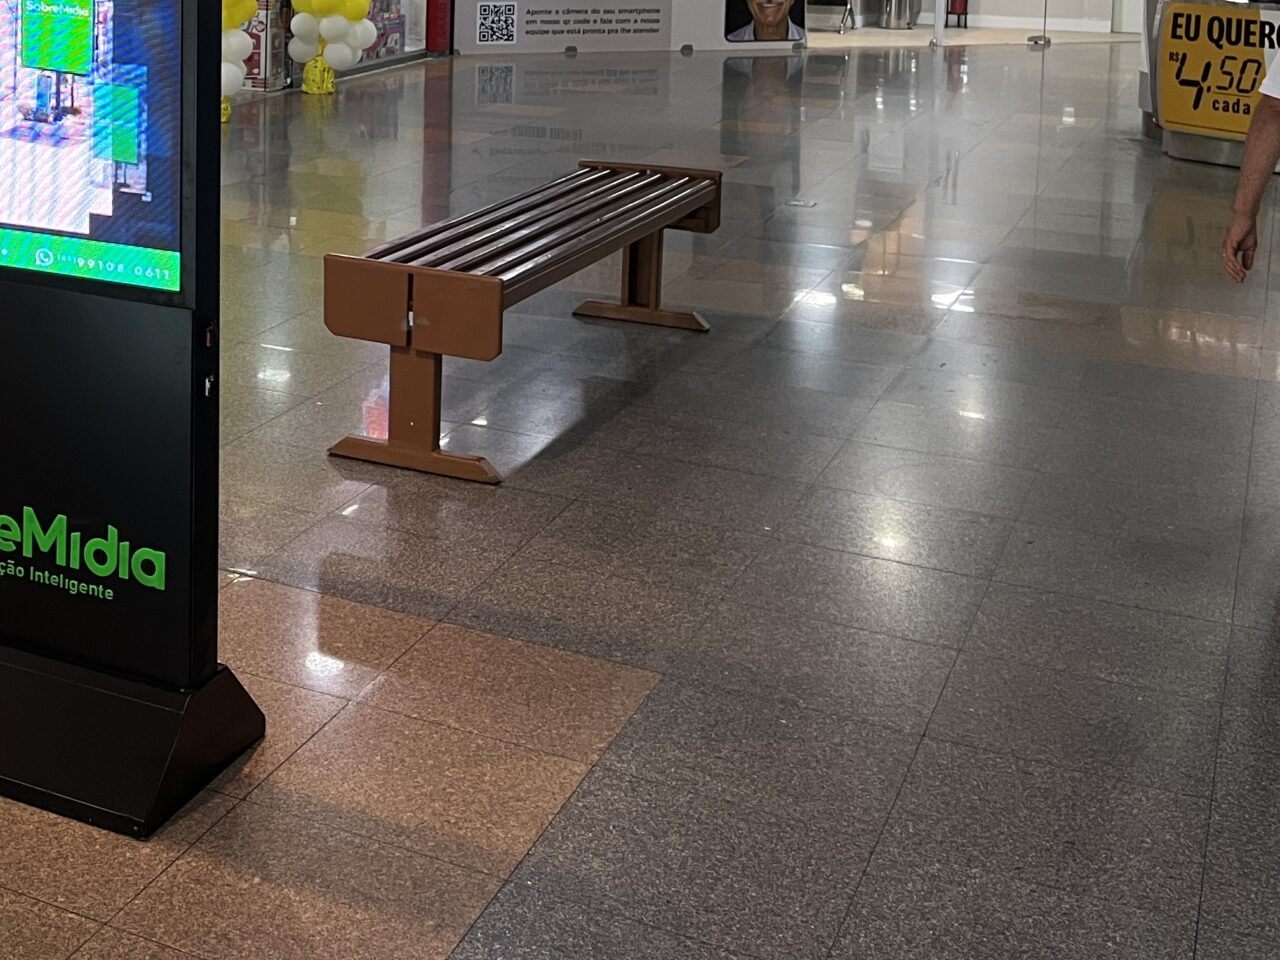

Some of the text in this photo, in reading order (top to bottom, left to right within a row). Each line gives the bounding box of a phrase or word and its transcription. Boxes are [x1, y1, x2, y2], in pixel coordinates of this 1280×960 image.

[1171, 12, 1280, 50] EU QUER
[1169, 51, 1179, 62] R$
[1212, 98, 1251, 115] cada
[29, 566, 114, 600] Inteligente
